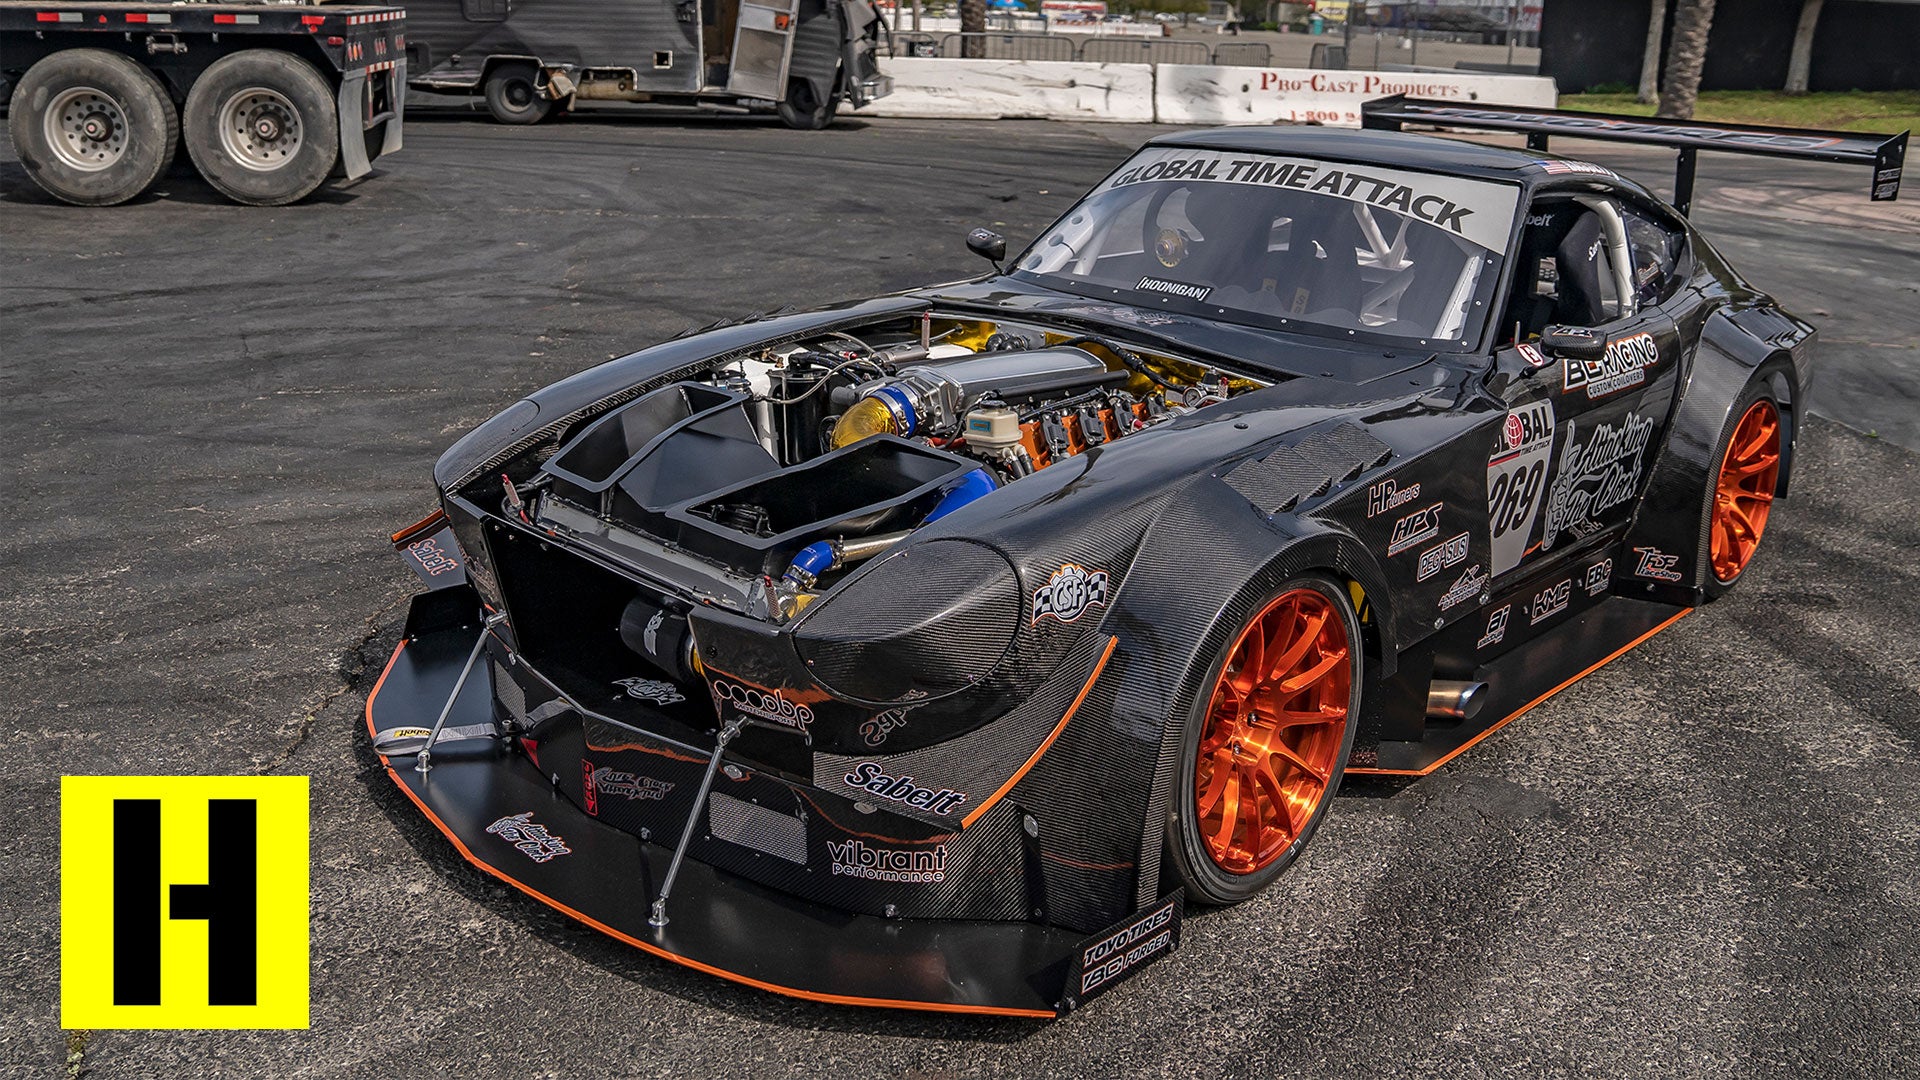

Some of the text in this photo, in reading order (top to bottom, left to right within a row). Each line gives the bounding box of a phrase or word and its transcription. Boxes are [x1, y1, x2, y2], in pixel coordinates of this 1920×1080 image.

[1363, 76, 1459, 97] PRODUCTS
[1290, 110, 1338, 122] 1-800
[1111, 159, 1475, 234] GLOBAL TIME ATTACK
[1526, 213, 1555, 227] belt
[1603, 332, 1660, 378] RACING
[1587, 377, 1613, 398] CUSTOM
[1571, 411, 1653, 484] Attacking
[1488, 460, 1544, 538] 269
[1560, 489, 1592, 531] The
[1592, 461, 1642, 517] Clock
[1391, 502, 1443, 543] HPS
[408, 538, 458, 577] Sabelt
[1419, 533, 1468, 580] PEGASUS
[1585, 558, 1613, 590] EBC
[1053, 579, 1084, 612] CSF
[1531, 579, 1572, 619] KMC
[844, 762, 966, 816] Sabelt
[827, 840, 947, 871] vibrant
[832, 862, 945, 882] performance
[1083, 902, 1174, 967] TOYO TIRES
[1123, 930, 1171, 969] FORGED
